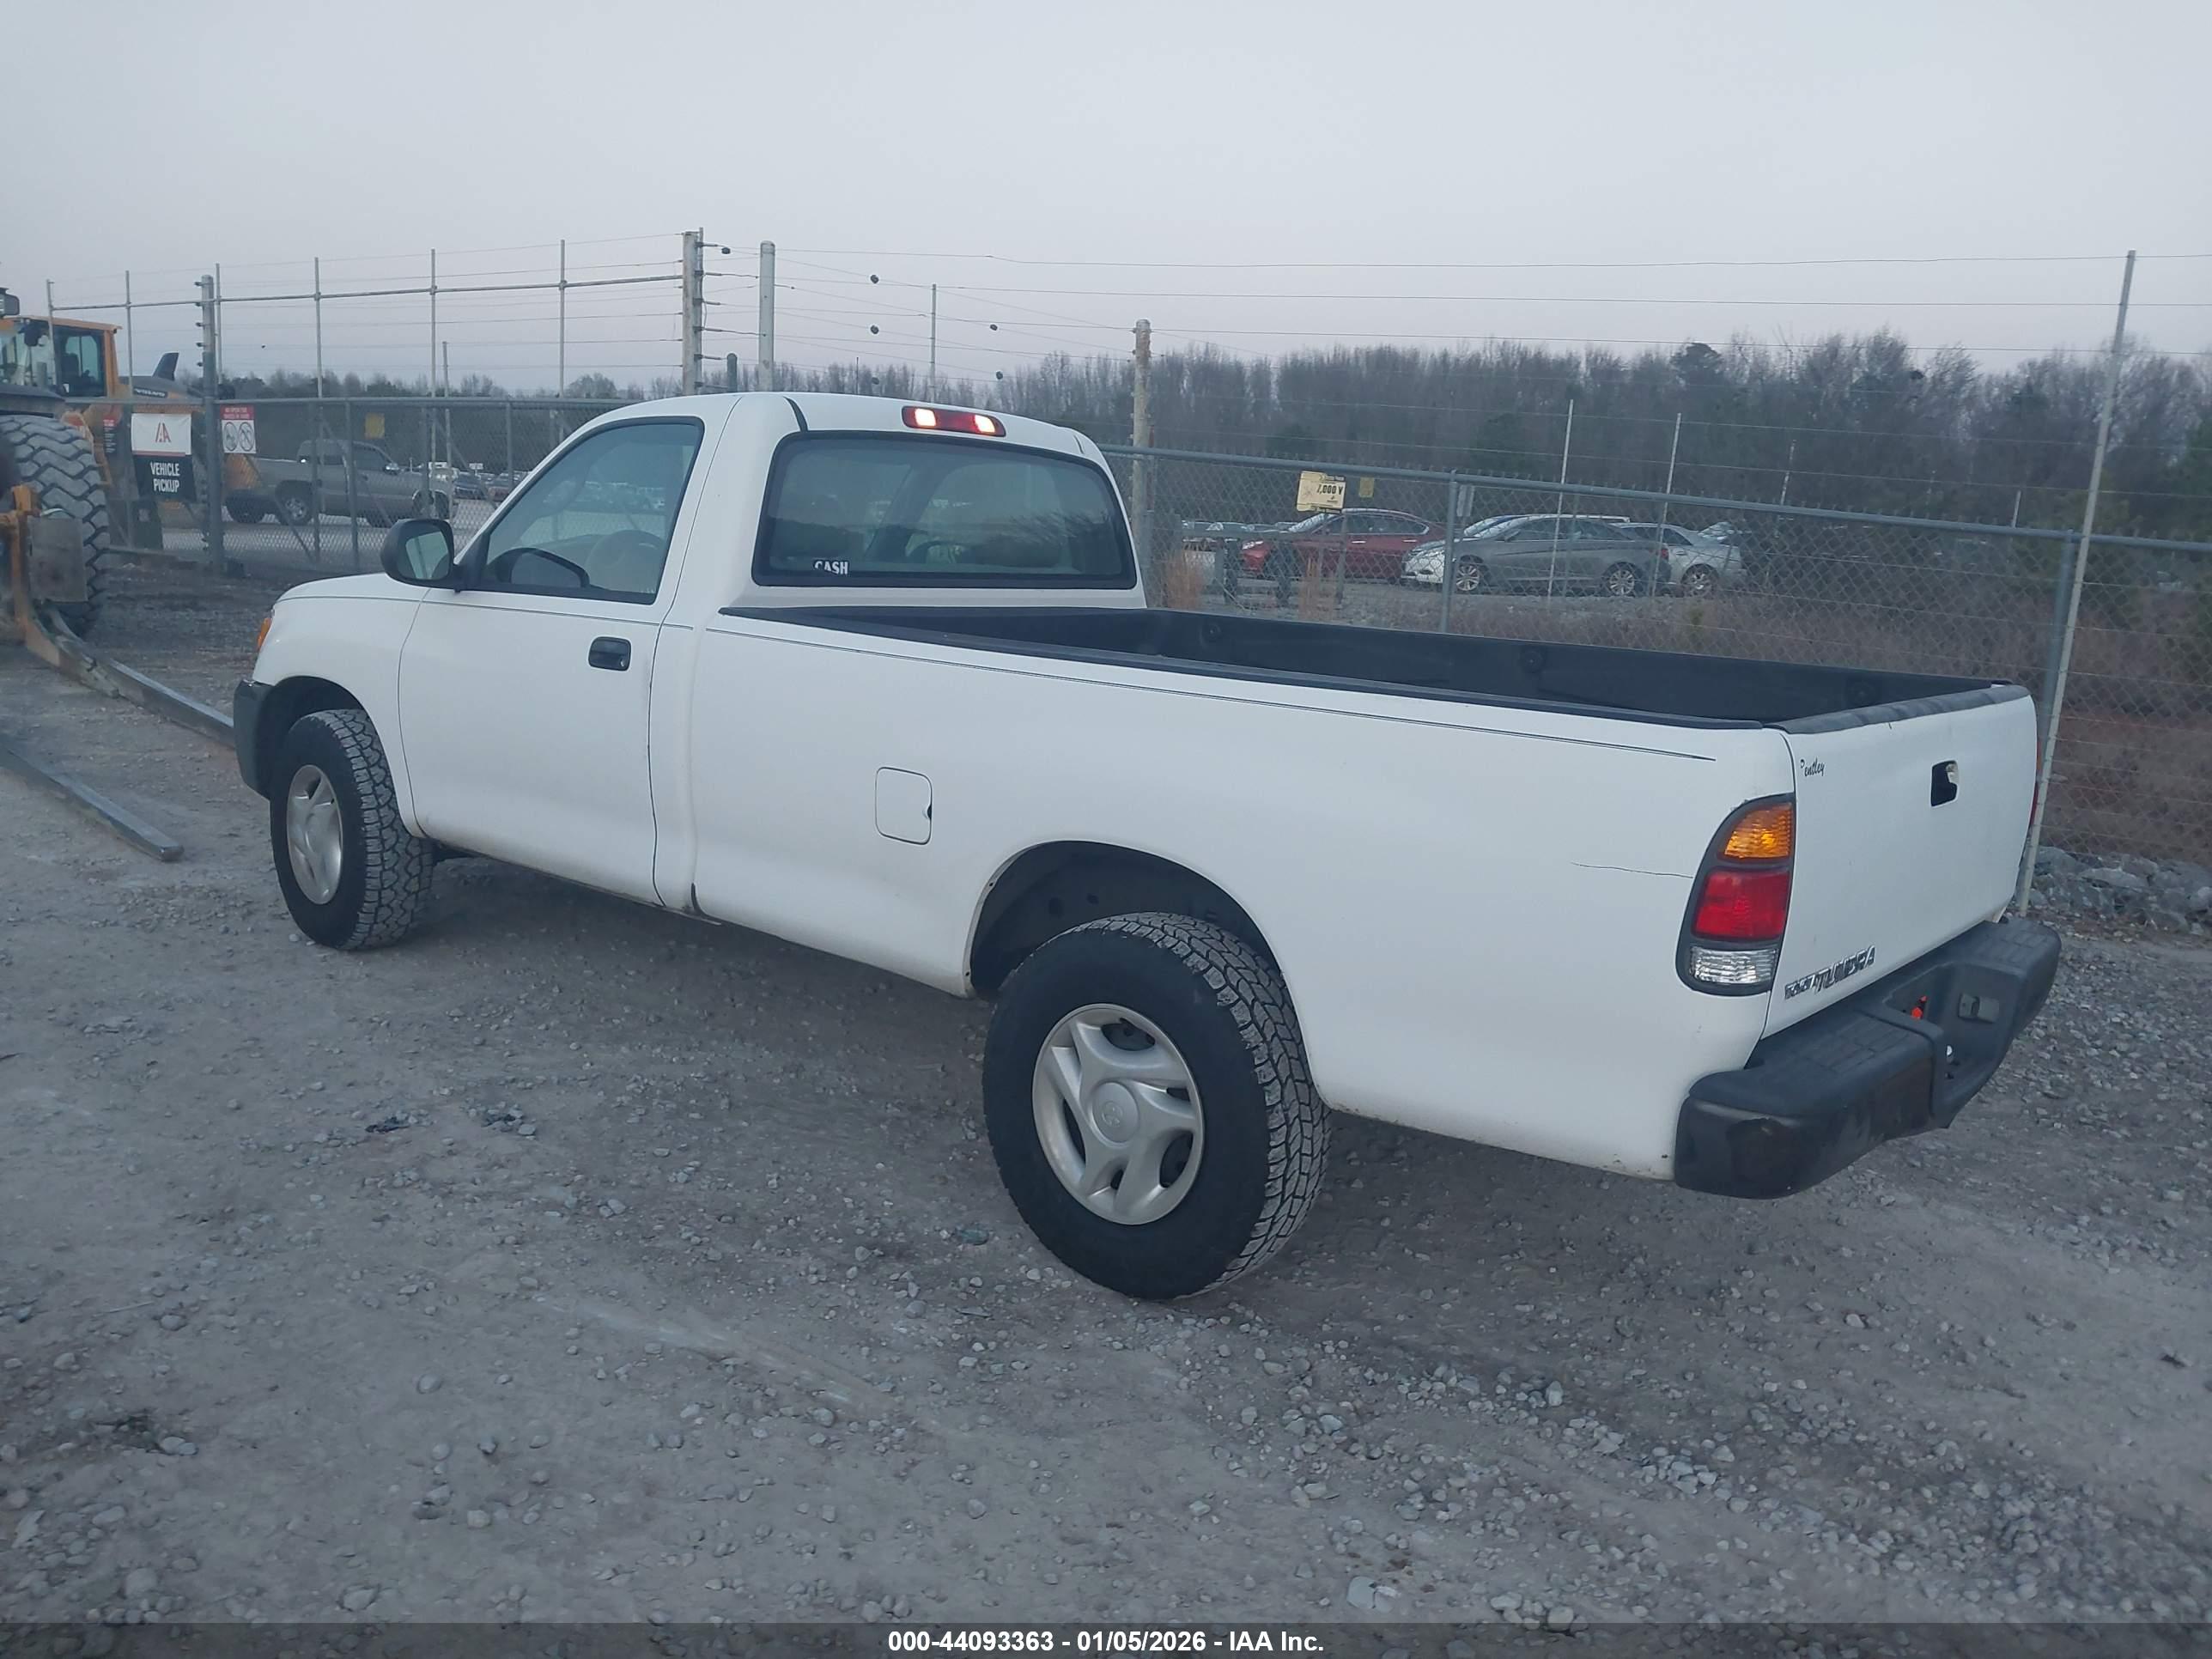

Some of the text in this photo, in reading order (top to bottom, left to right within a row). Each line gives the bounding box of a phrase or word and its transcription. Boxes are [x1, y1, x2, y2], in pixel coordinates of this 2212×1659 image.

[150, 462, 180, 477] VEHICLE
[153, 478, 179, 493] PICKUP
[814, 560, 848, 575] CASH
